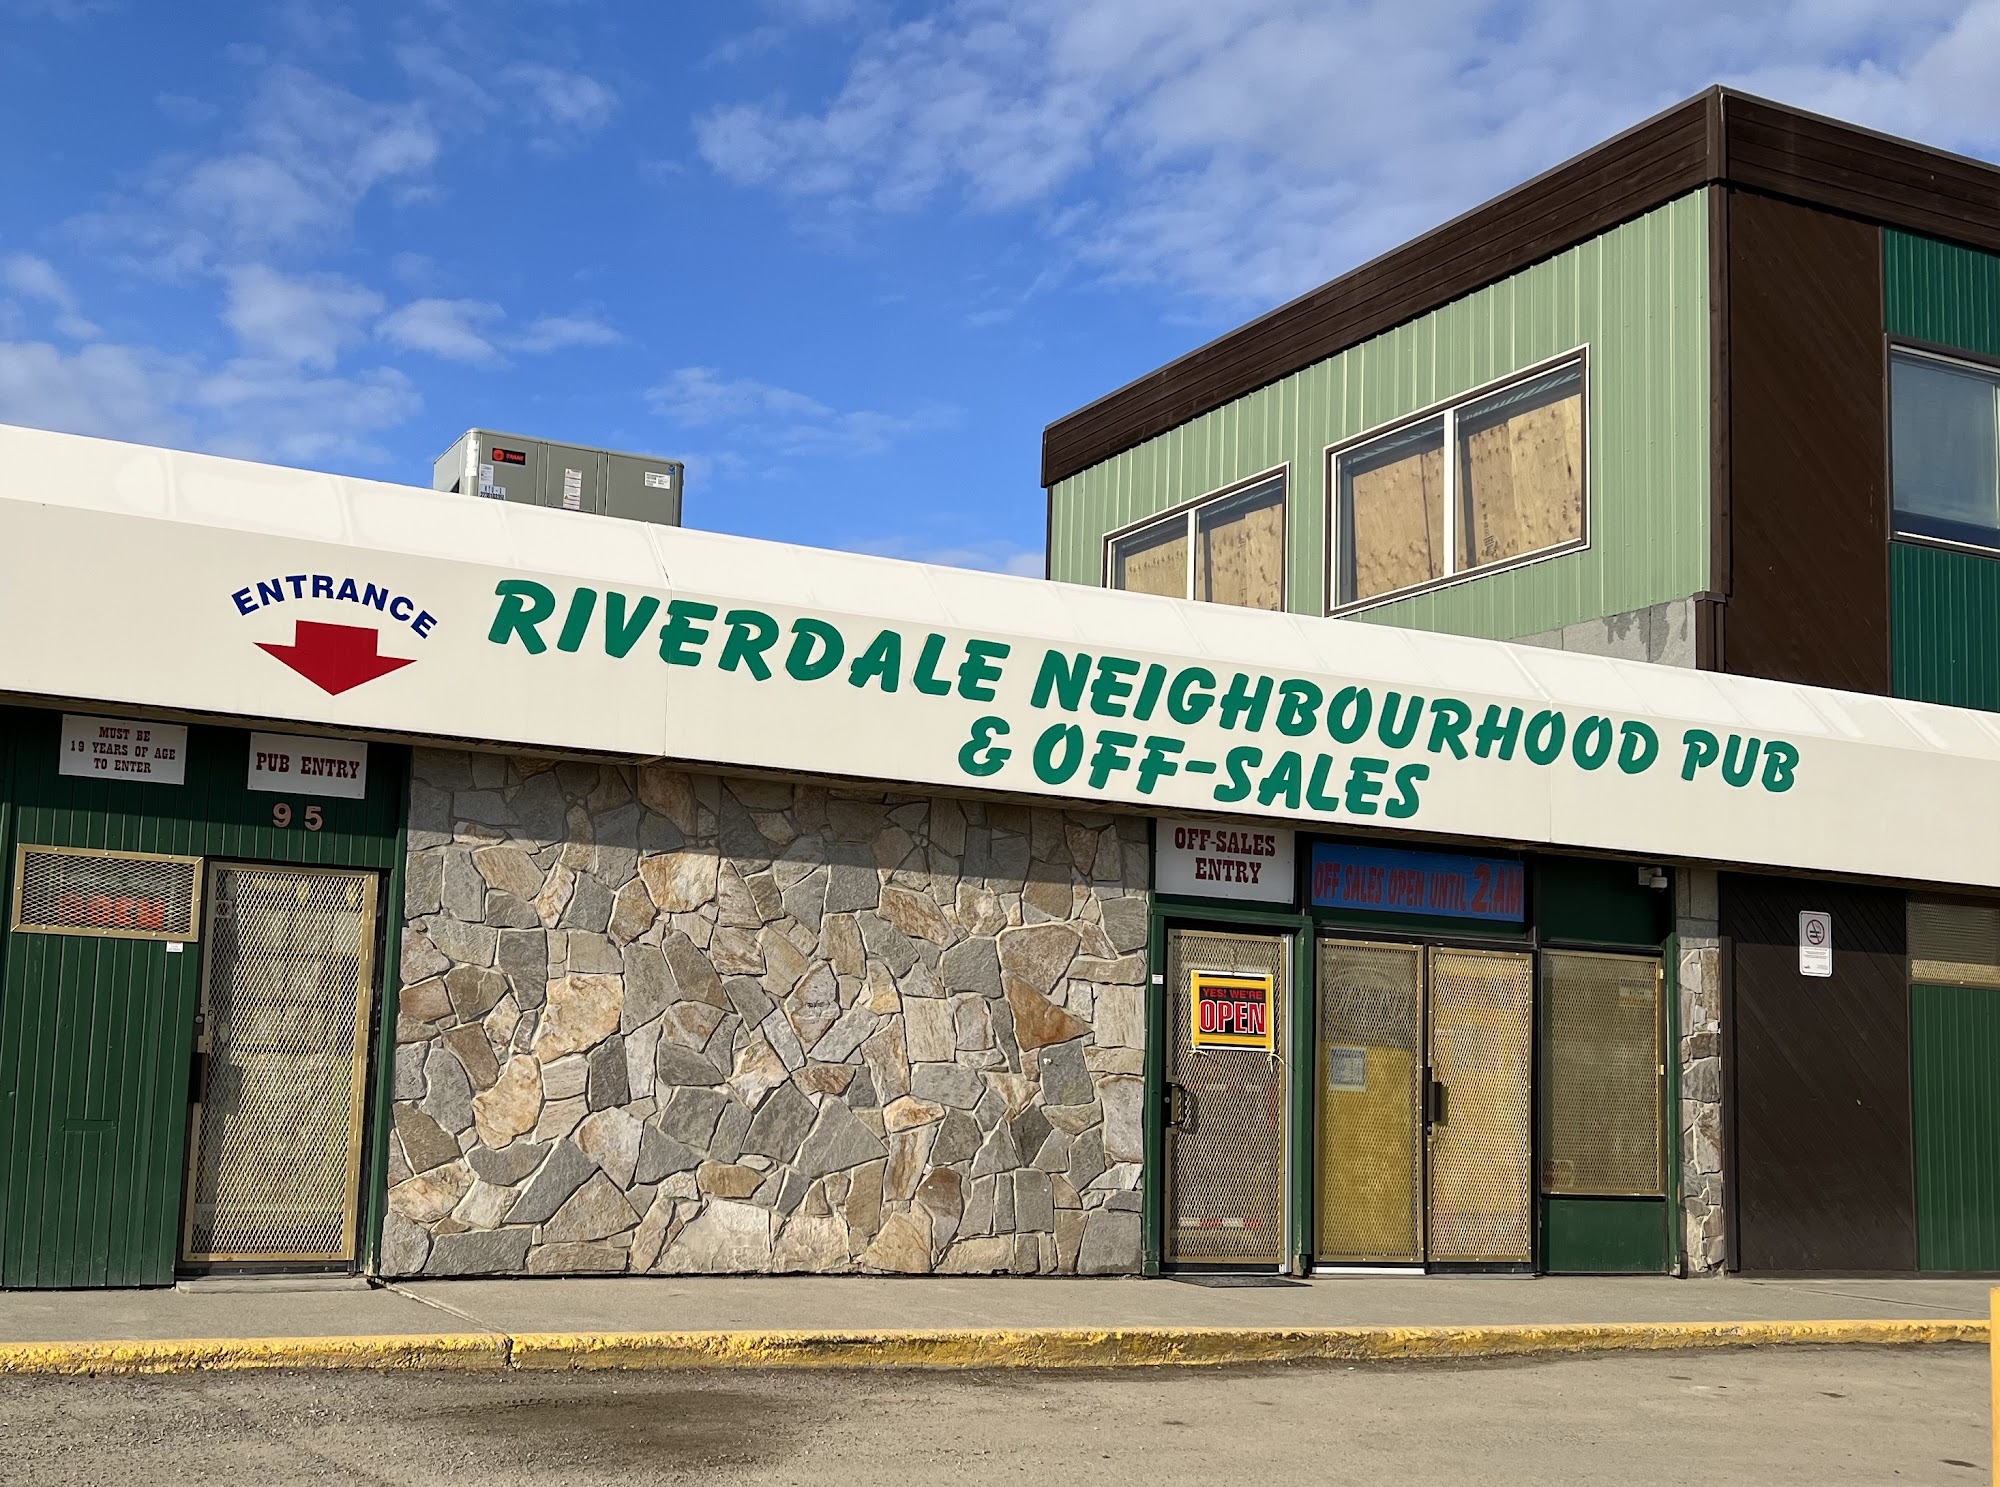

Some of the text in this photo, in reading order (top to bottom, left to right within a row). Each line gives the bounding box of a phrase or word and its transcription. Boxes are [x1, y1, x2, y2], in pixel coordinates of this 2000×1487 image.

[234, 576, 436, 637] ENTRANCE
[489, 580, 1799, 792] RIVERDALE NEIGHBOURHOOD PUB
[71, 740, 176, 760] 19 YEARS OF AGE
[99, 726, 151, 742] MUST BE
[94, 758, 151, 773] TO ENTER
[256, 752, 360, 779] PUB ENTRY
[959, 716, 1430, 818] & OFF-SALES
[1174, 827, 1276, 884] OFF-SALES ENTRY
[1314, 862, 1341, 899] OFF
[1343, 864, 1385, 904] SALES
[1388, 868, 1425, 907] OPEN
[1429, 872, 1467, 912] UNTIL
[1202, 988, 1263, 1000] YES! WE'RE
[1199, 999, 1266, 1034] OPEN
